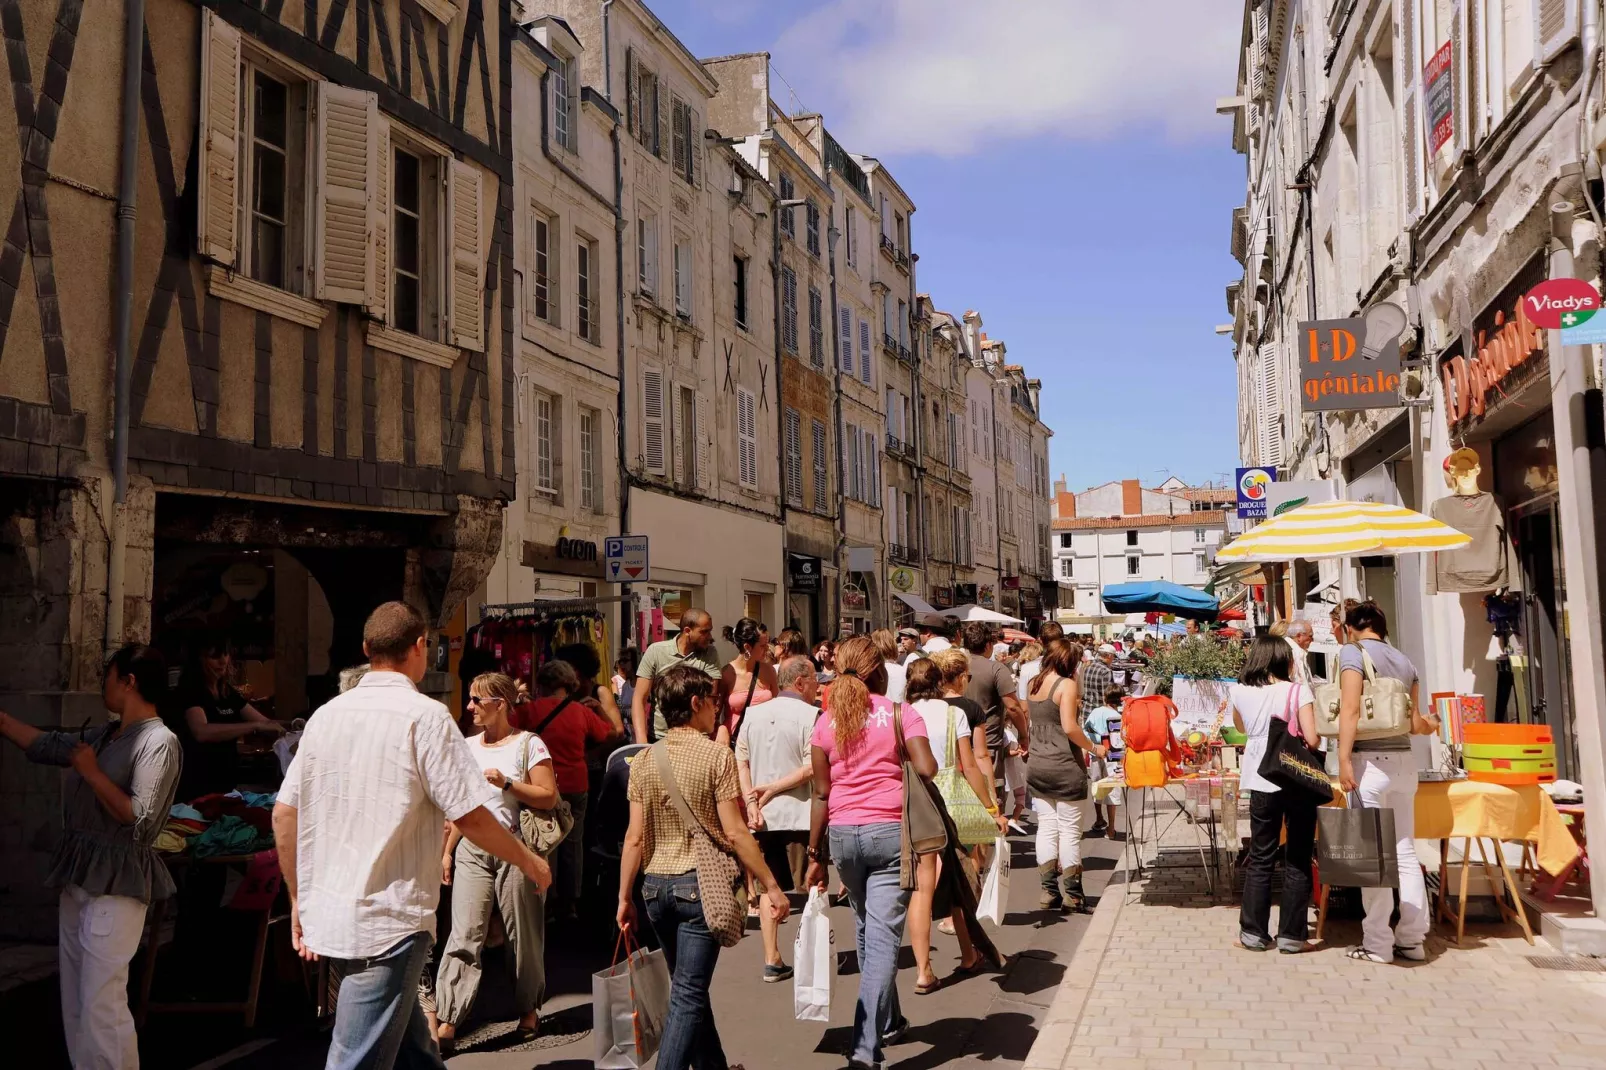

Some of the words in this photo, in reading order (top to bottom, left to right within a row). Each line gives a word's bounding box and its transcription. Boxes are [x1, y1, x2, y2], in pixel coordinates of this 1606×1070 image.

[1527, 295, 1593, 312] Viadys
[1305, 368, 1399, 402] géniale
[609, 541, 620, 556] P
